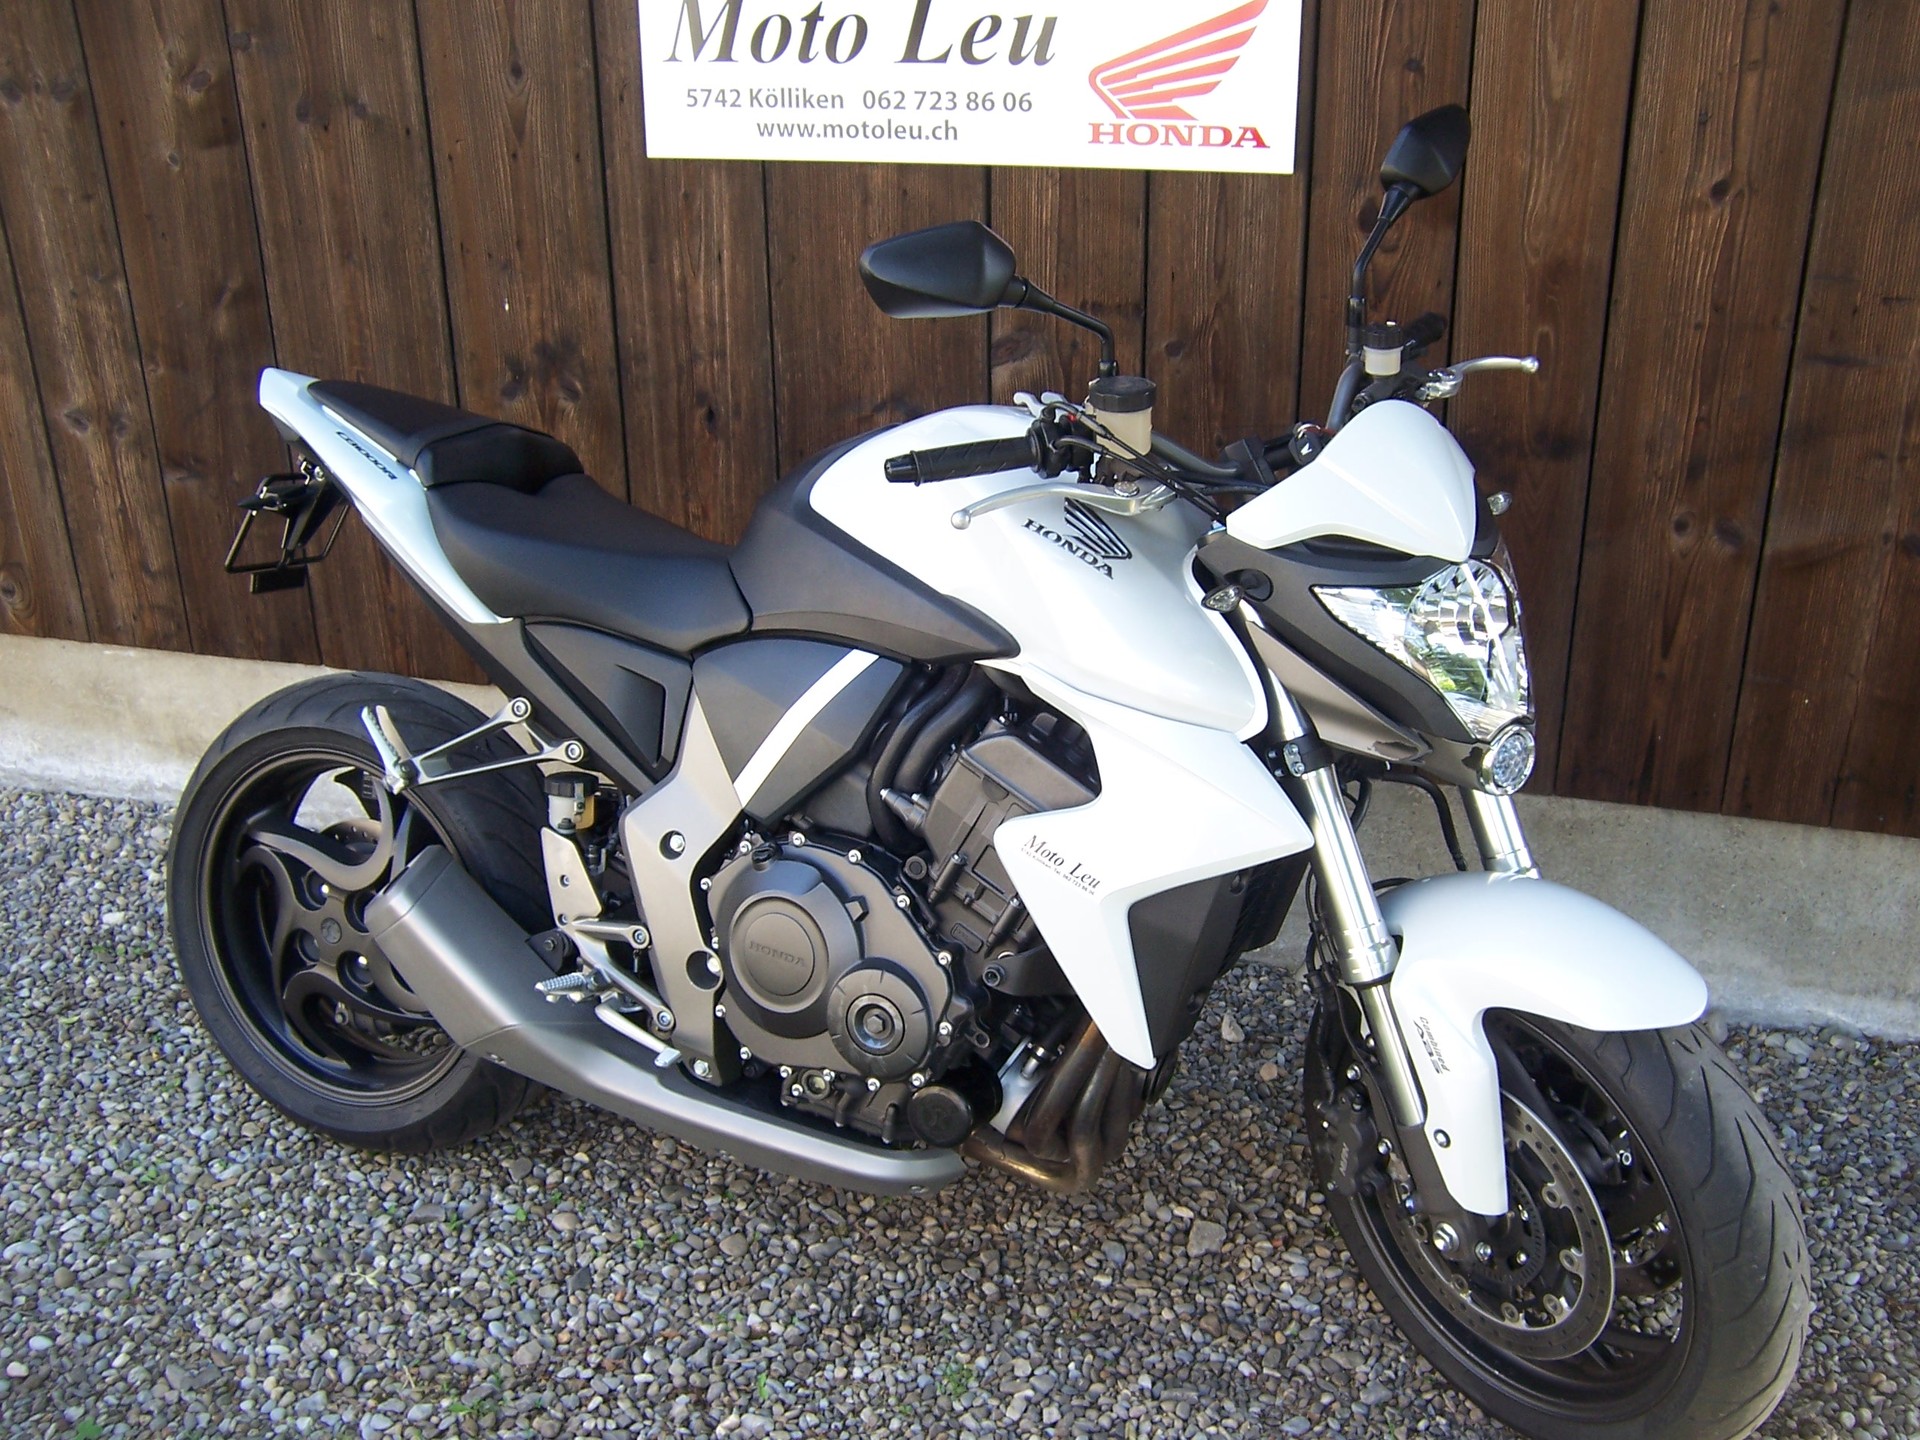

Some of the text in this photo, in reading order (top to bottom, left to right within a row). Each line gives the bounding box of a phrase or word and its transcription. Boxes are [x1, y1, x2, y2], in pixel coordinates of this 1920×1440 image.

[663, 0, 1058, 66] Moto Leu
[686, 87, 1032, 112] 5742 Kölliken 062 723 86 06
[756, 119, 958, 141] www.motoleu.ch
[1088, 122, 1270, 149] HONDA
[1021, 518, 1114, 580] HONDA
[1024, 834, 1065, 867] Moto
[1069, 862, 1101, 889] Leu
[749, 940, 806, 967] HONDA
[1419, 1016, 1450, 1072] Combined
